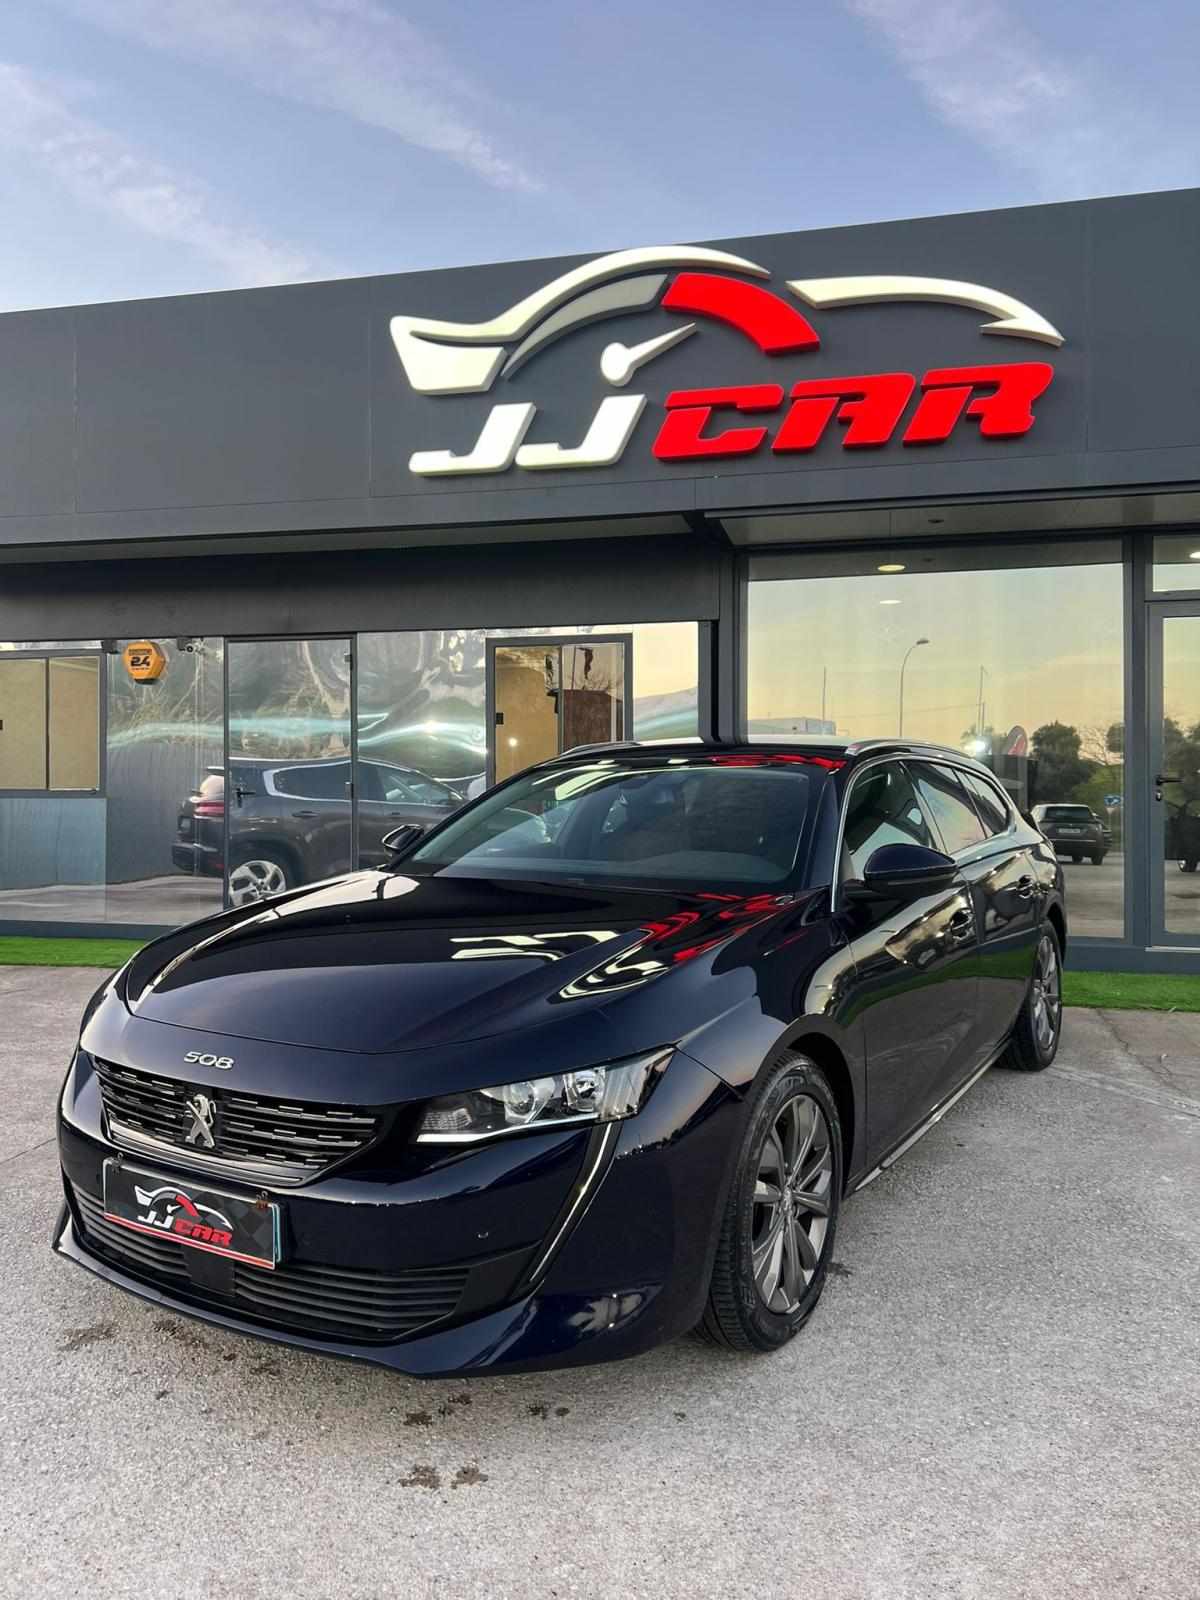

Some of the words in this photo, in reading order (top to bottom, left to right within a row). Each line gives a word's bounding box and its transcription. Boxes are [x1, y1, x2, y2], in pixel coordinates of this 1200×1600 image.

[409, 394, 648, 477] JJ
[651, 361, 1054, 462] CAR
[130, 656, 151, 667] 24
[183, 1050, 234, 1069] 508
[137, 1210, 174, 1229] JJ
[173, 1218, 233, 1247] CAR
